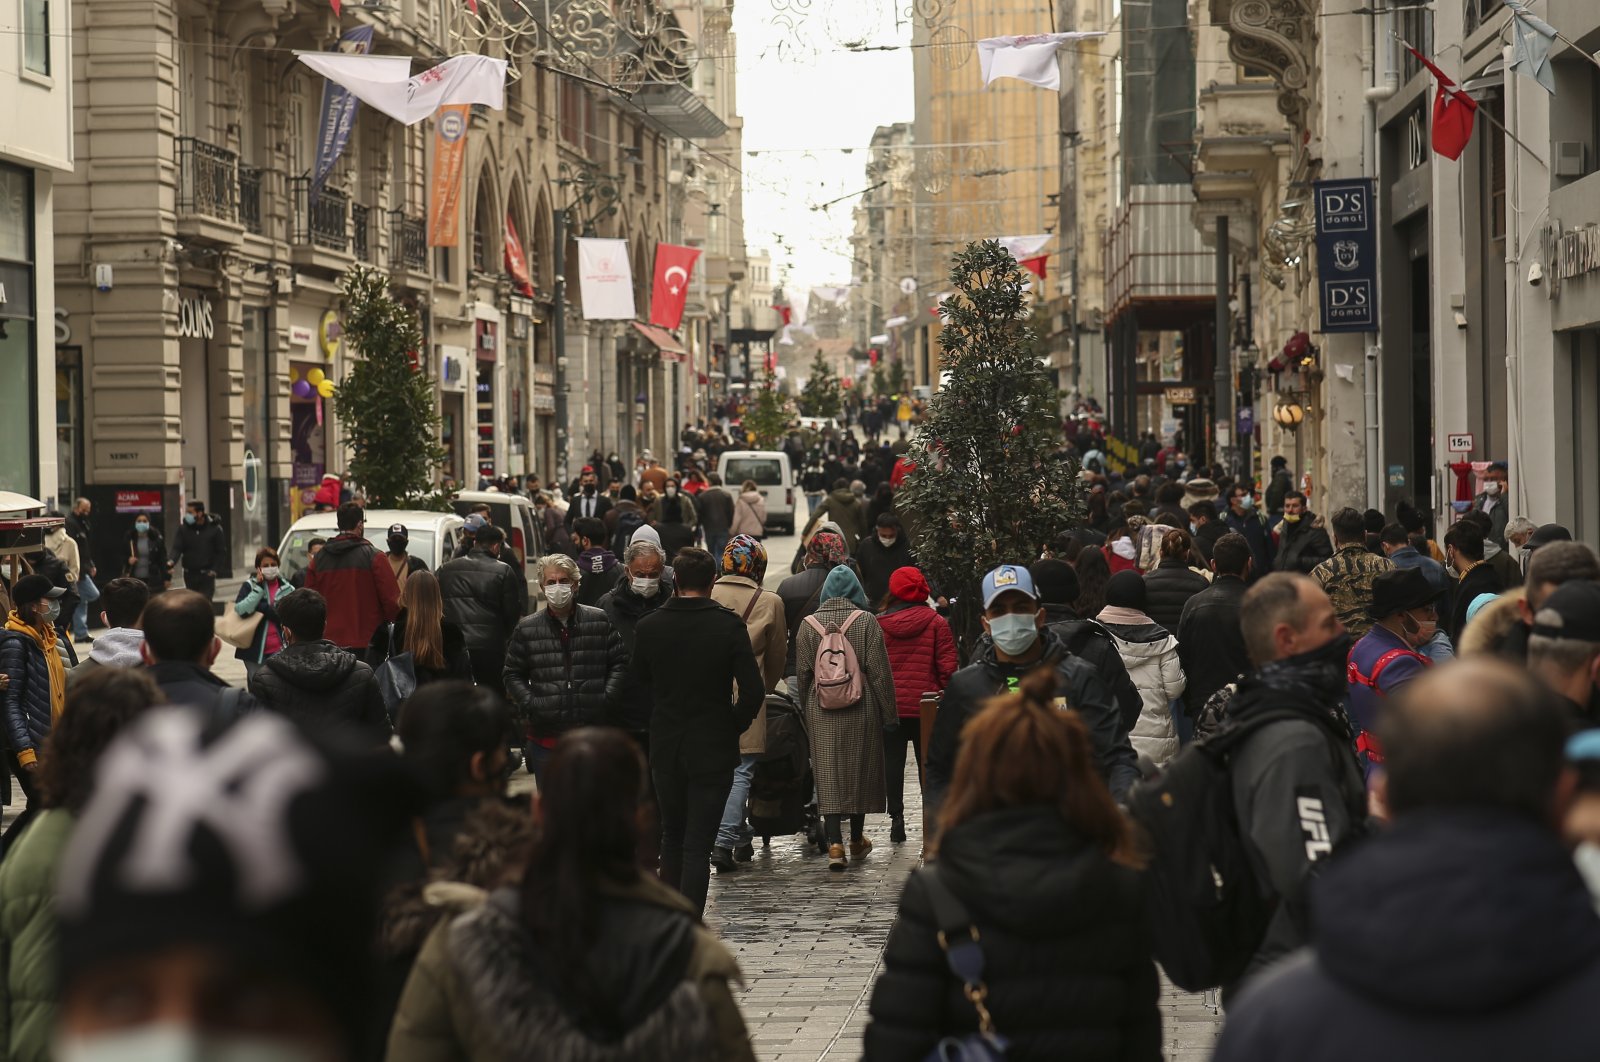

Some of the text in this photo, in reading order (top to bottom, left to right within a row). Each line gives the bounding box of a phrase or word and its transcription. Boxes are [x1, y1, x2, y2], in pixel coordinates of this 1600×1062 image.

[1326, 193, 1361, 213] D'S
[1326, 215, 1362, 223] damat
[1331, 286, 1366, 306] D'S
[1331, 308, 1367, 317] damat
[1297, 796, 1333, 861] UFC
